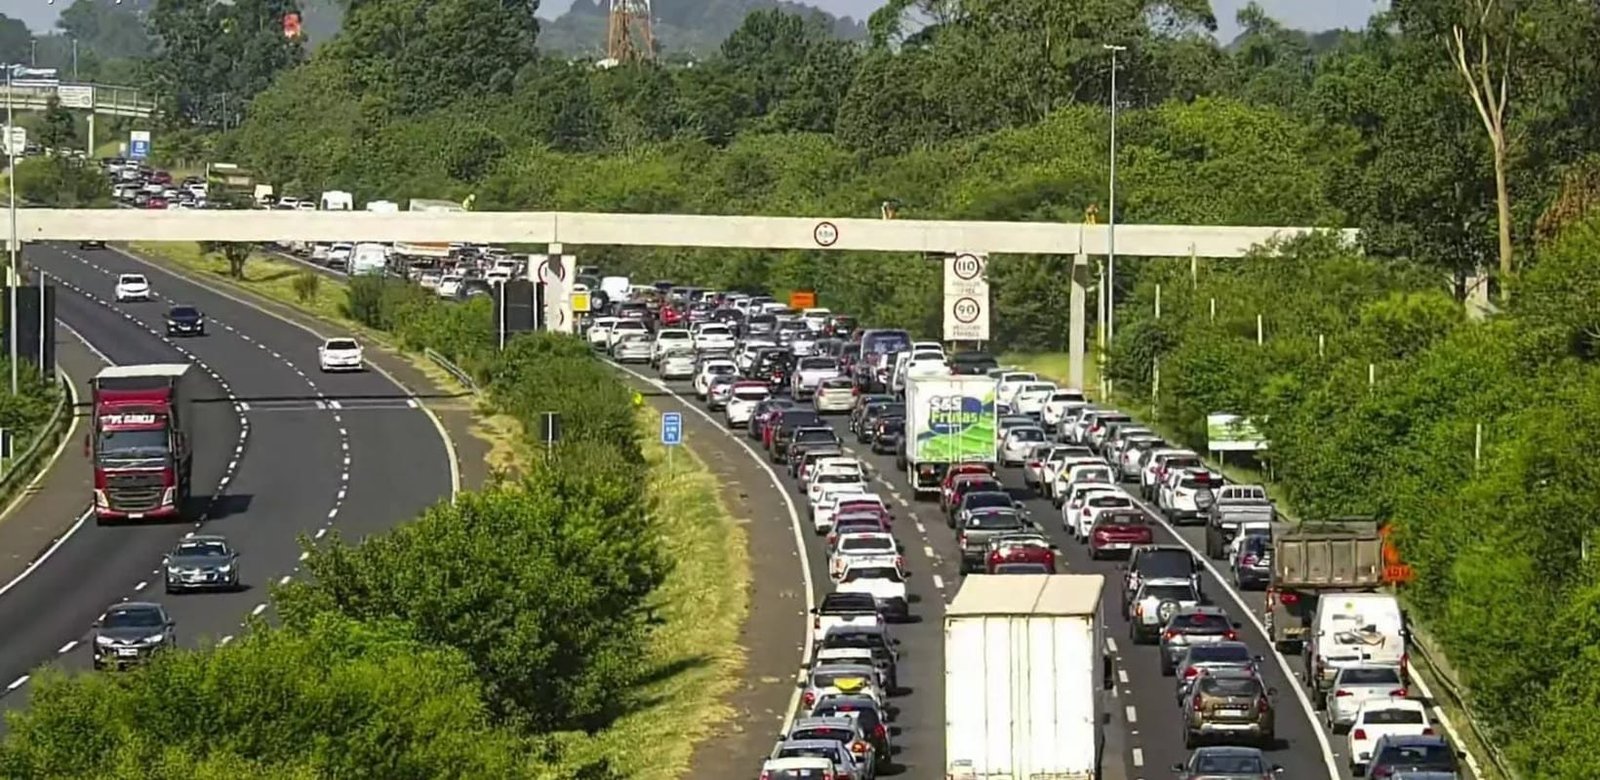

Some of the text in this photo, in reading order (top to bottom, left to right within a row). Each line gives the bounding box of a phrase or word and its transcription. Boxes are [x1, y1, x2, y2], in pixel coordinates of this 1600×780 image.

[958, 260, 975, 272] 110
[958, 304, 975, 315] 90
[929, 395, 963, 412] S&S
